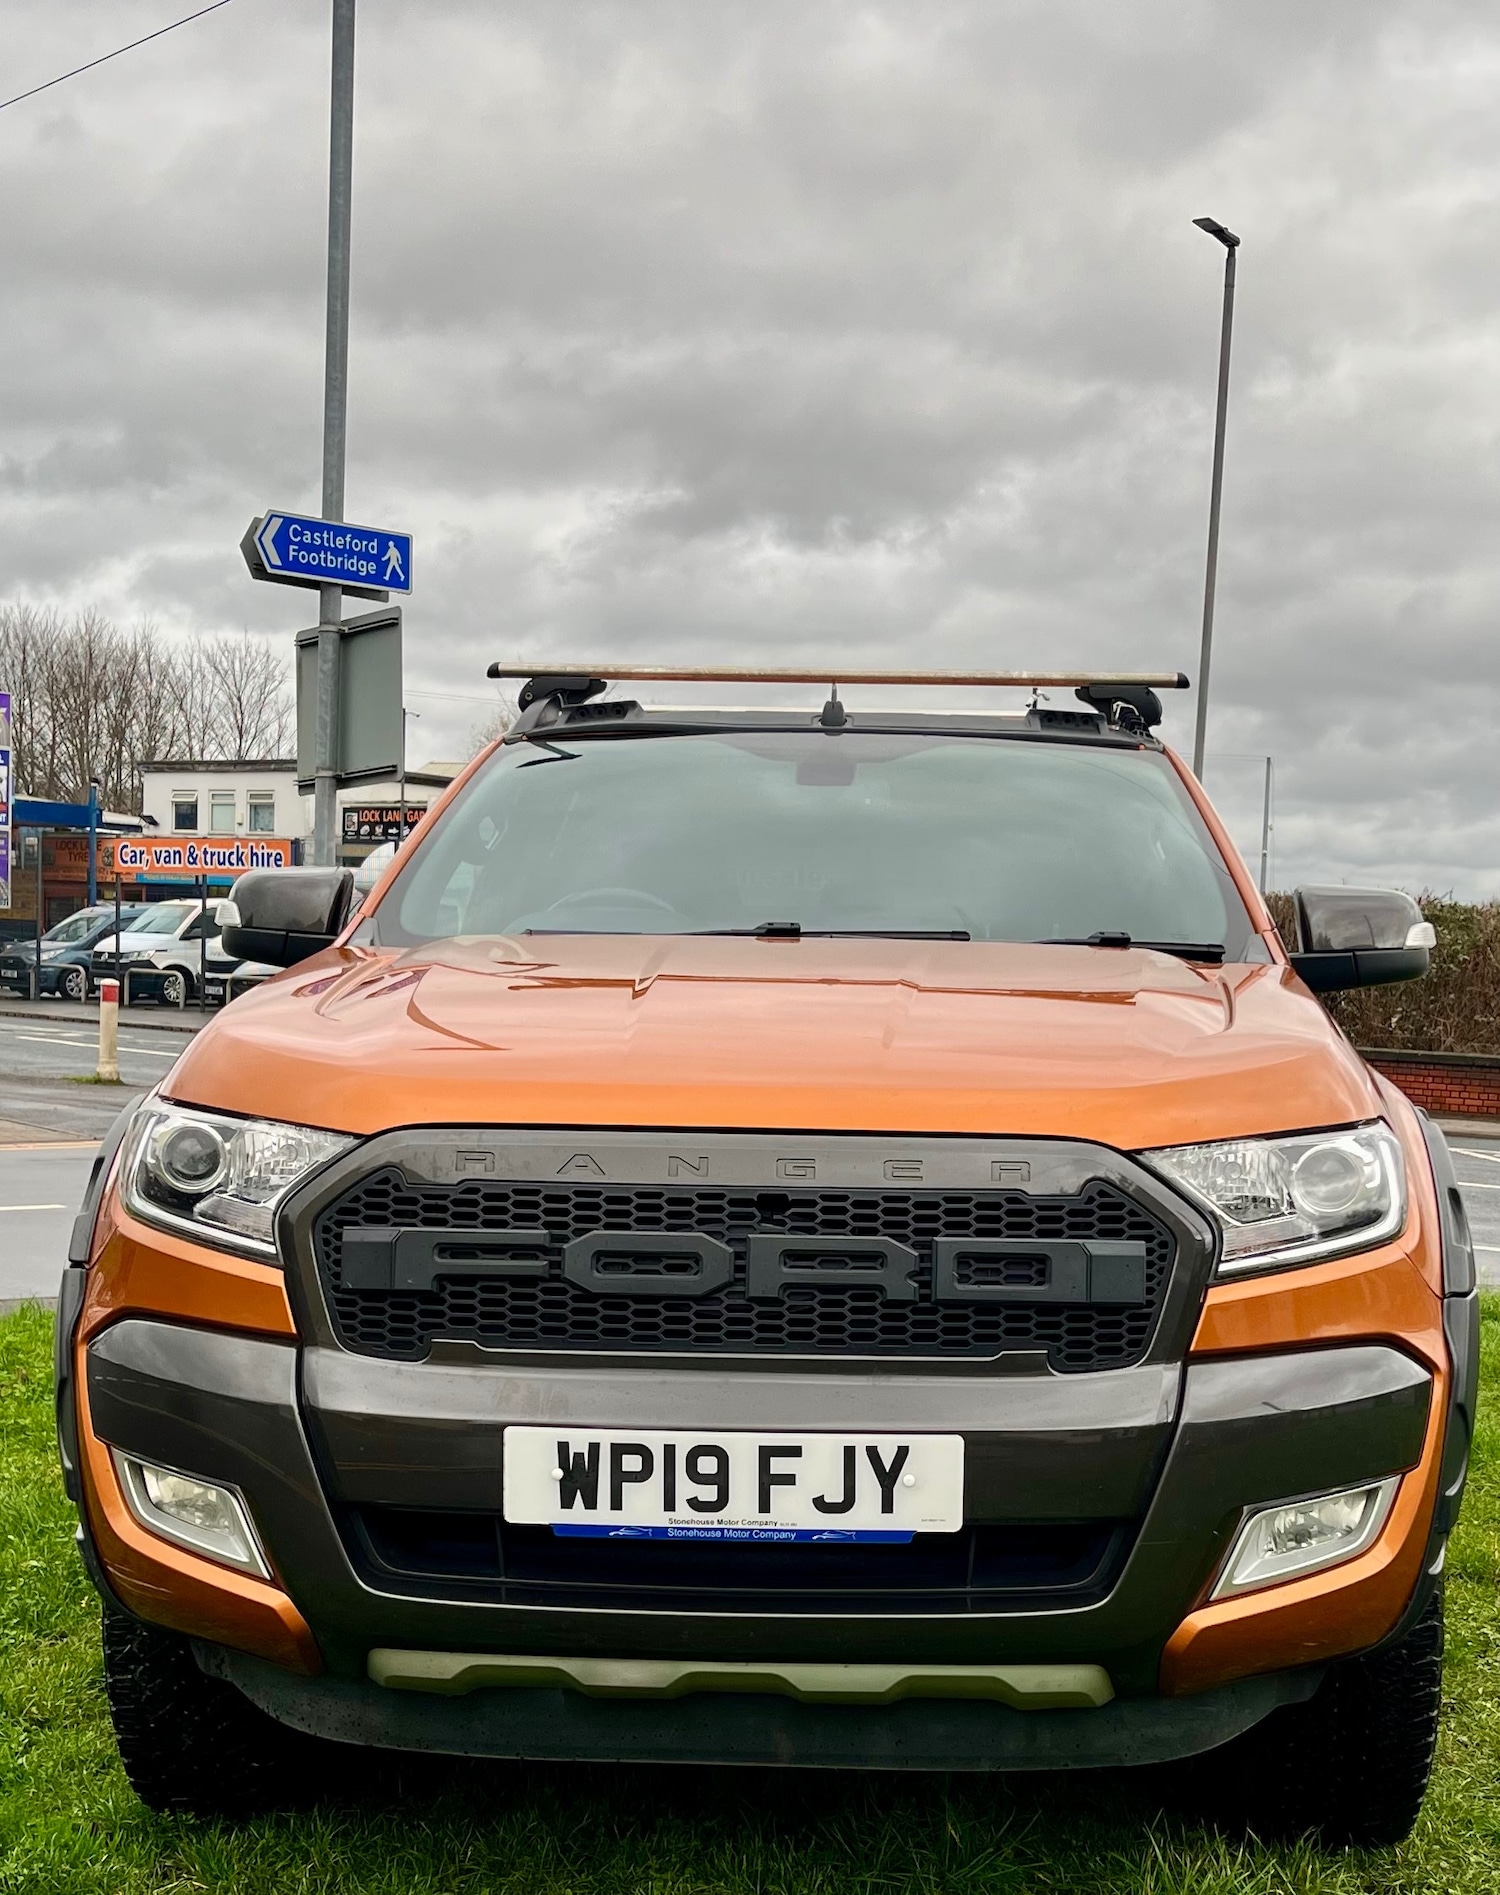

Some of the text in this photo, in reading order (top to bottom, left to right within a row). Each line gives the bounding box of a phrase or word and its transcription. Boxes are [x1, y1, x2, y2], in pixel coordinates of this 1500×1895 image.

[289, 524, 378, 554] Castleford
[289, 545, 377, 576] Footbridge
[359, 810, 380, 822] LOCK
[383, 810, 404, 822] LAN
[55, 841, 102, 852] LOCK LAE
[119, 843, 283, 868] Car, van & truck hire
[454, 1149, 1032, 1182] RANGER
[341, 1226, 1146, 1307] FORD
[556, 1440, 911, 1515] WP19 FJY
[667, 1517, 715, 1526] Stonehouse
[717, 1518, 739, 1526] Motor
[741, 1518, 778, 1527] Company
[667, 1528, 797, 1540] Stonehouse Motor Company
